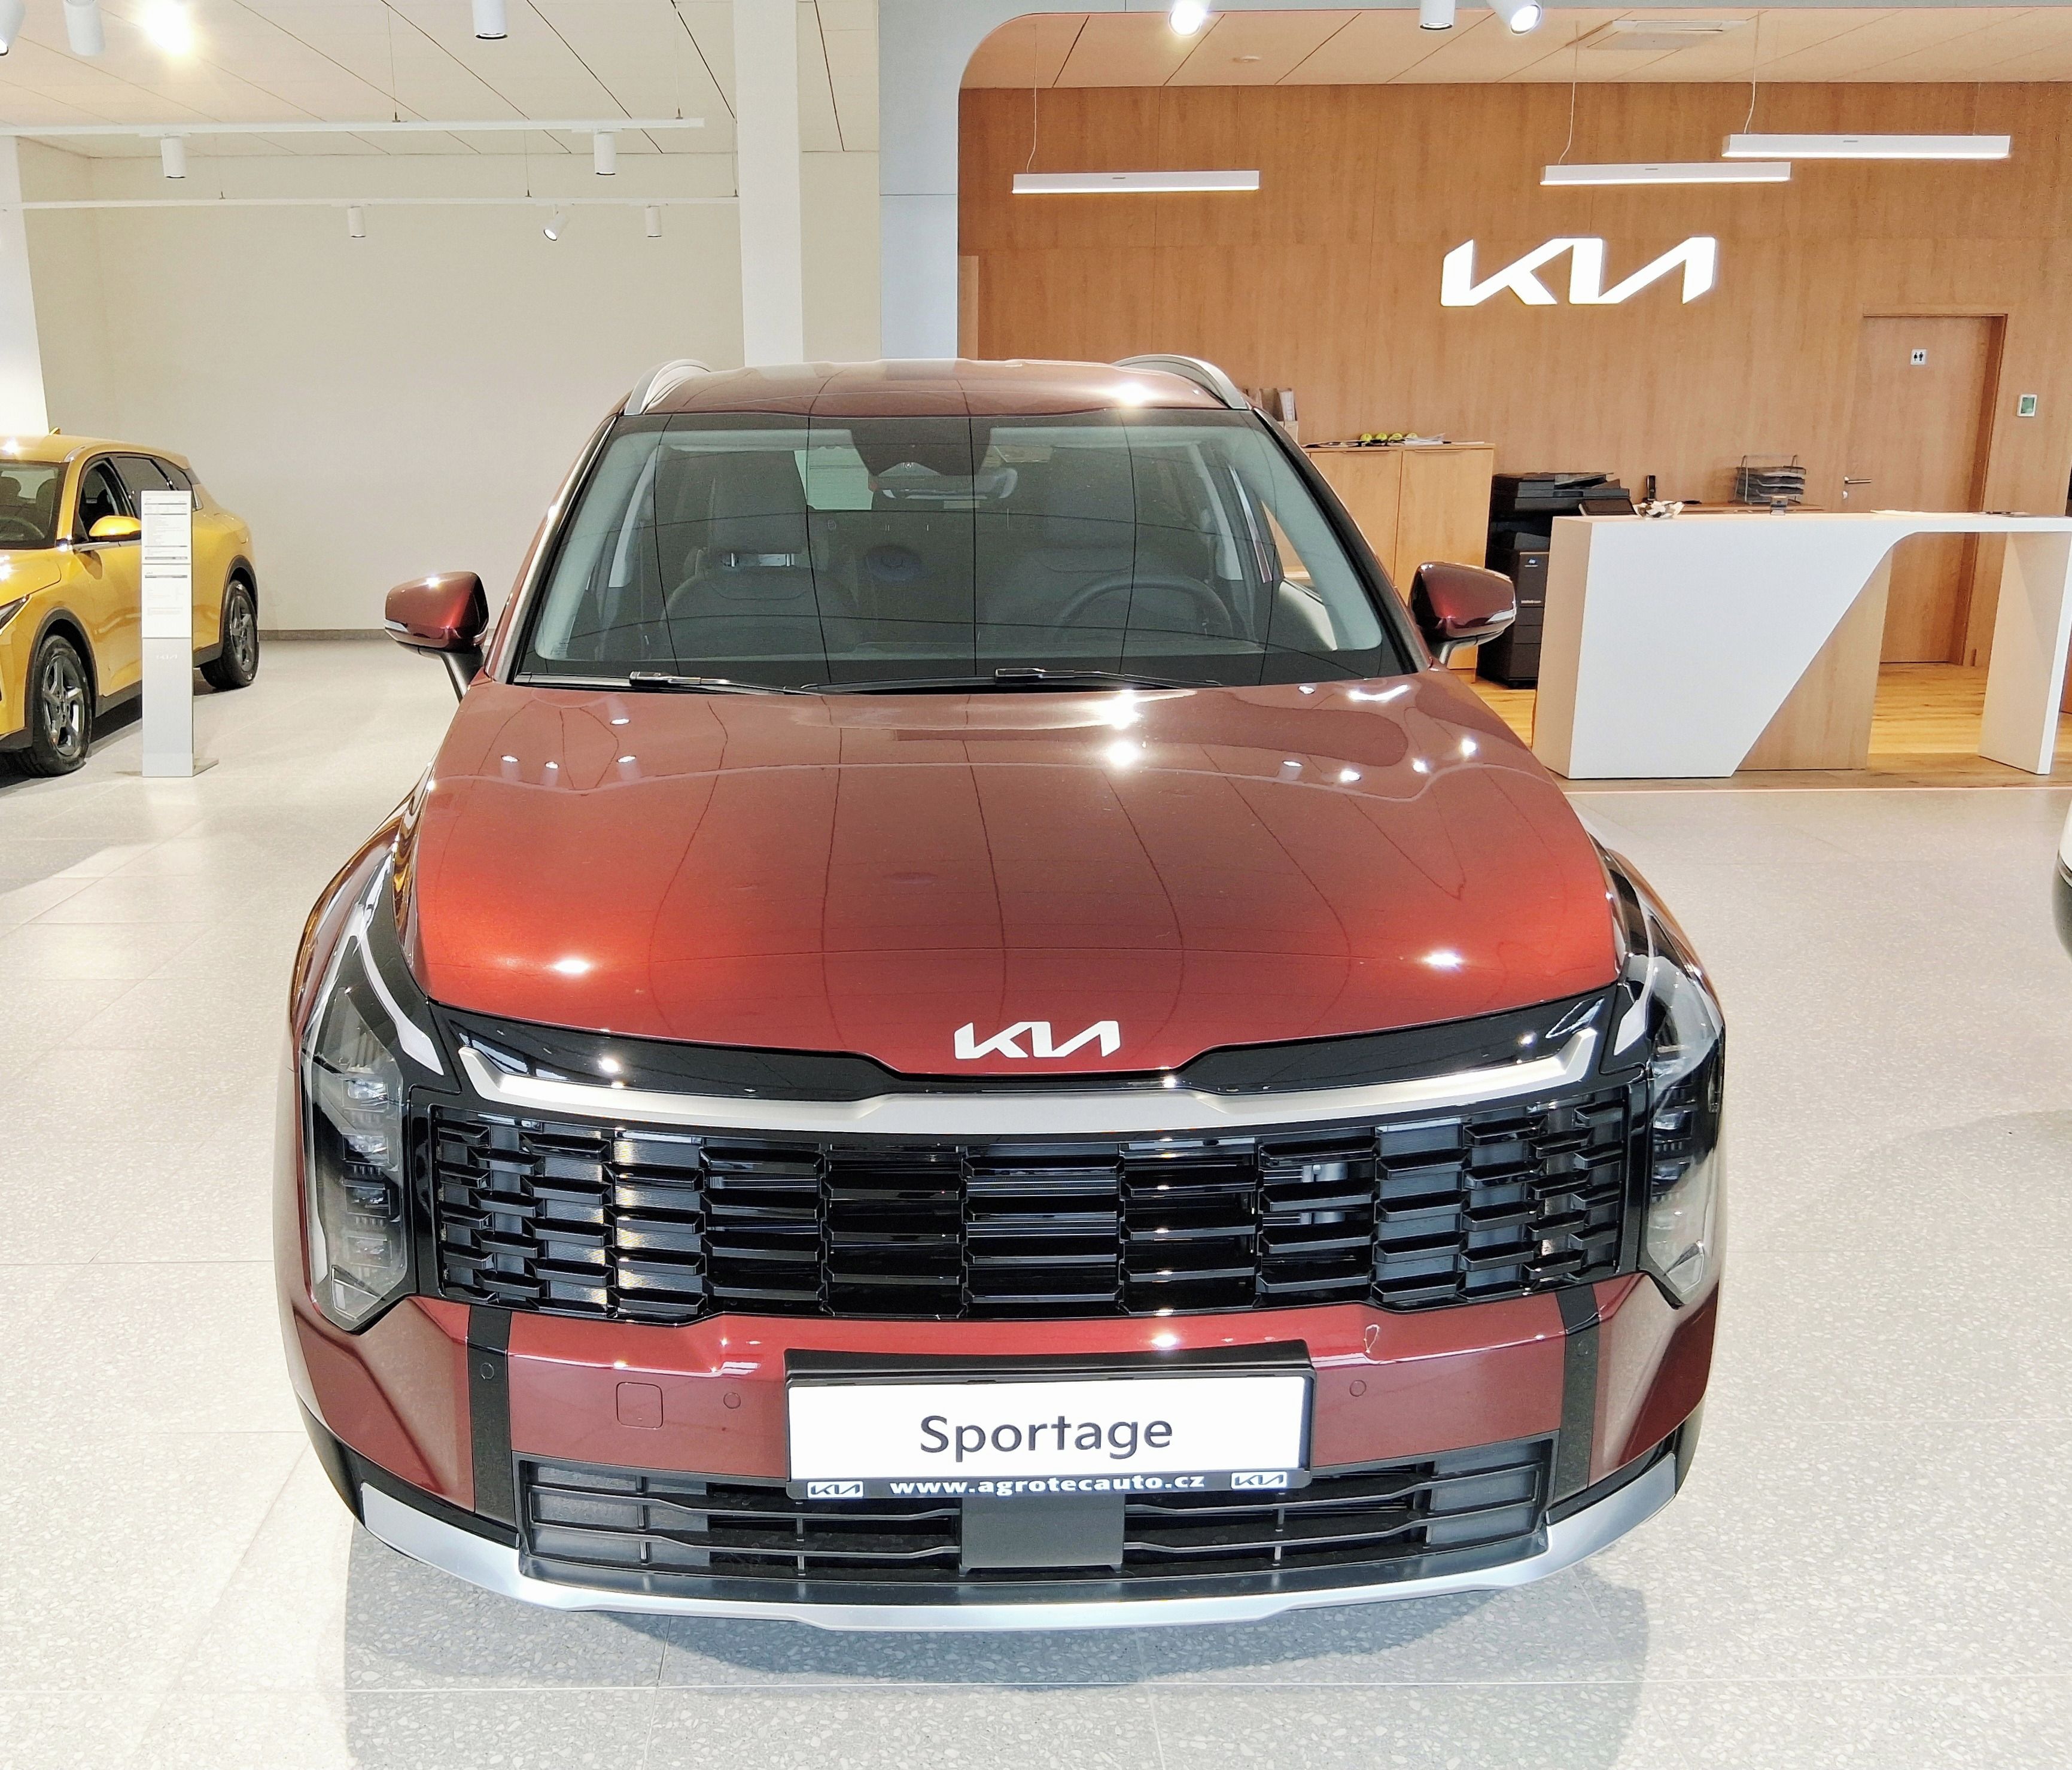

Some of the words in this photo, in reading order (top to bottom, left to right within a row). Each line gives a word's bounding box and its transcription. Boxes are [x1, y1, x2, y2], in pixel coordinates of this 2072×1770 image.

[1441, 237, 1715, 306] KIA
[954, 1020, 1121, 1059] KIA
[920, 1415, 1172, 1462] Sportage
[810, 1483, 860, 1495] KIA
[889, 1475, 1205, 1497] www.agrotecauto.cz
[1234, 1473, 1284, 1486] KIA
